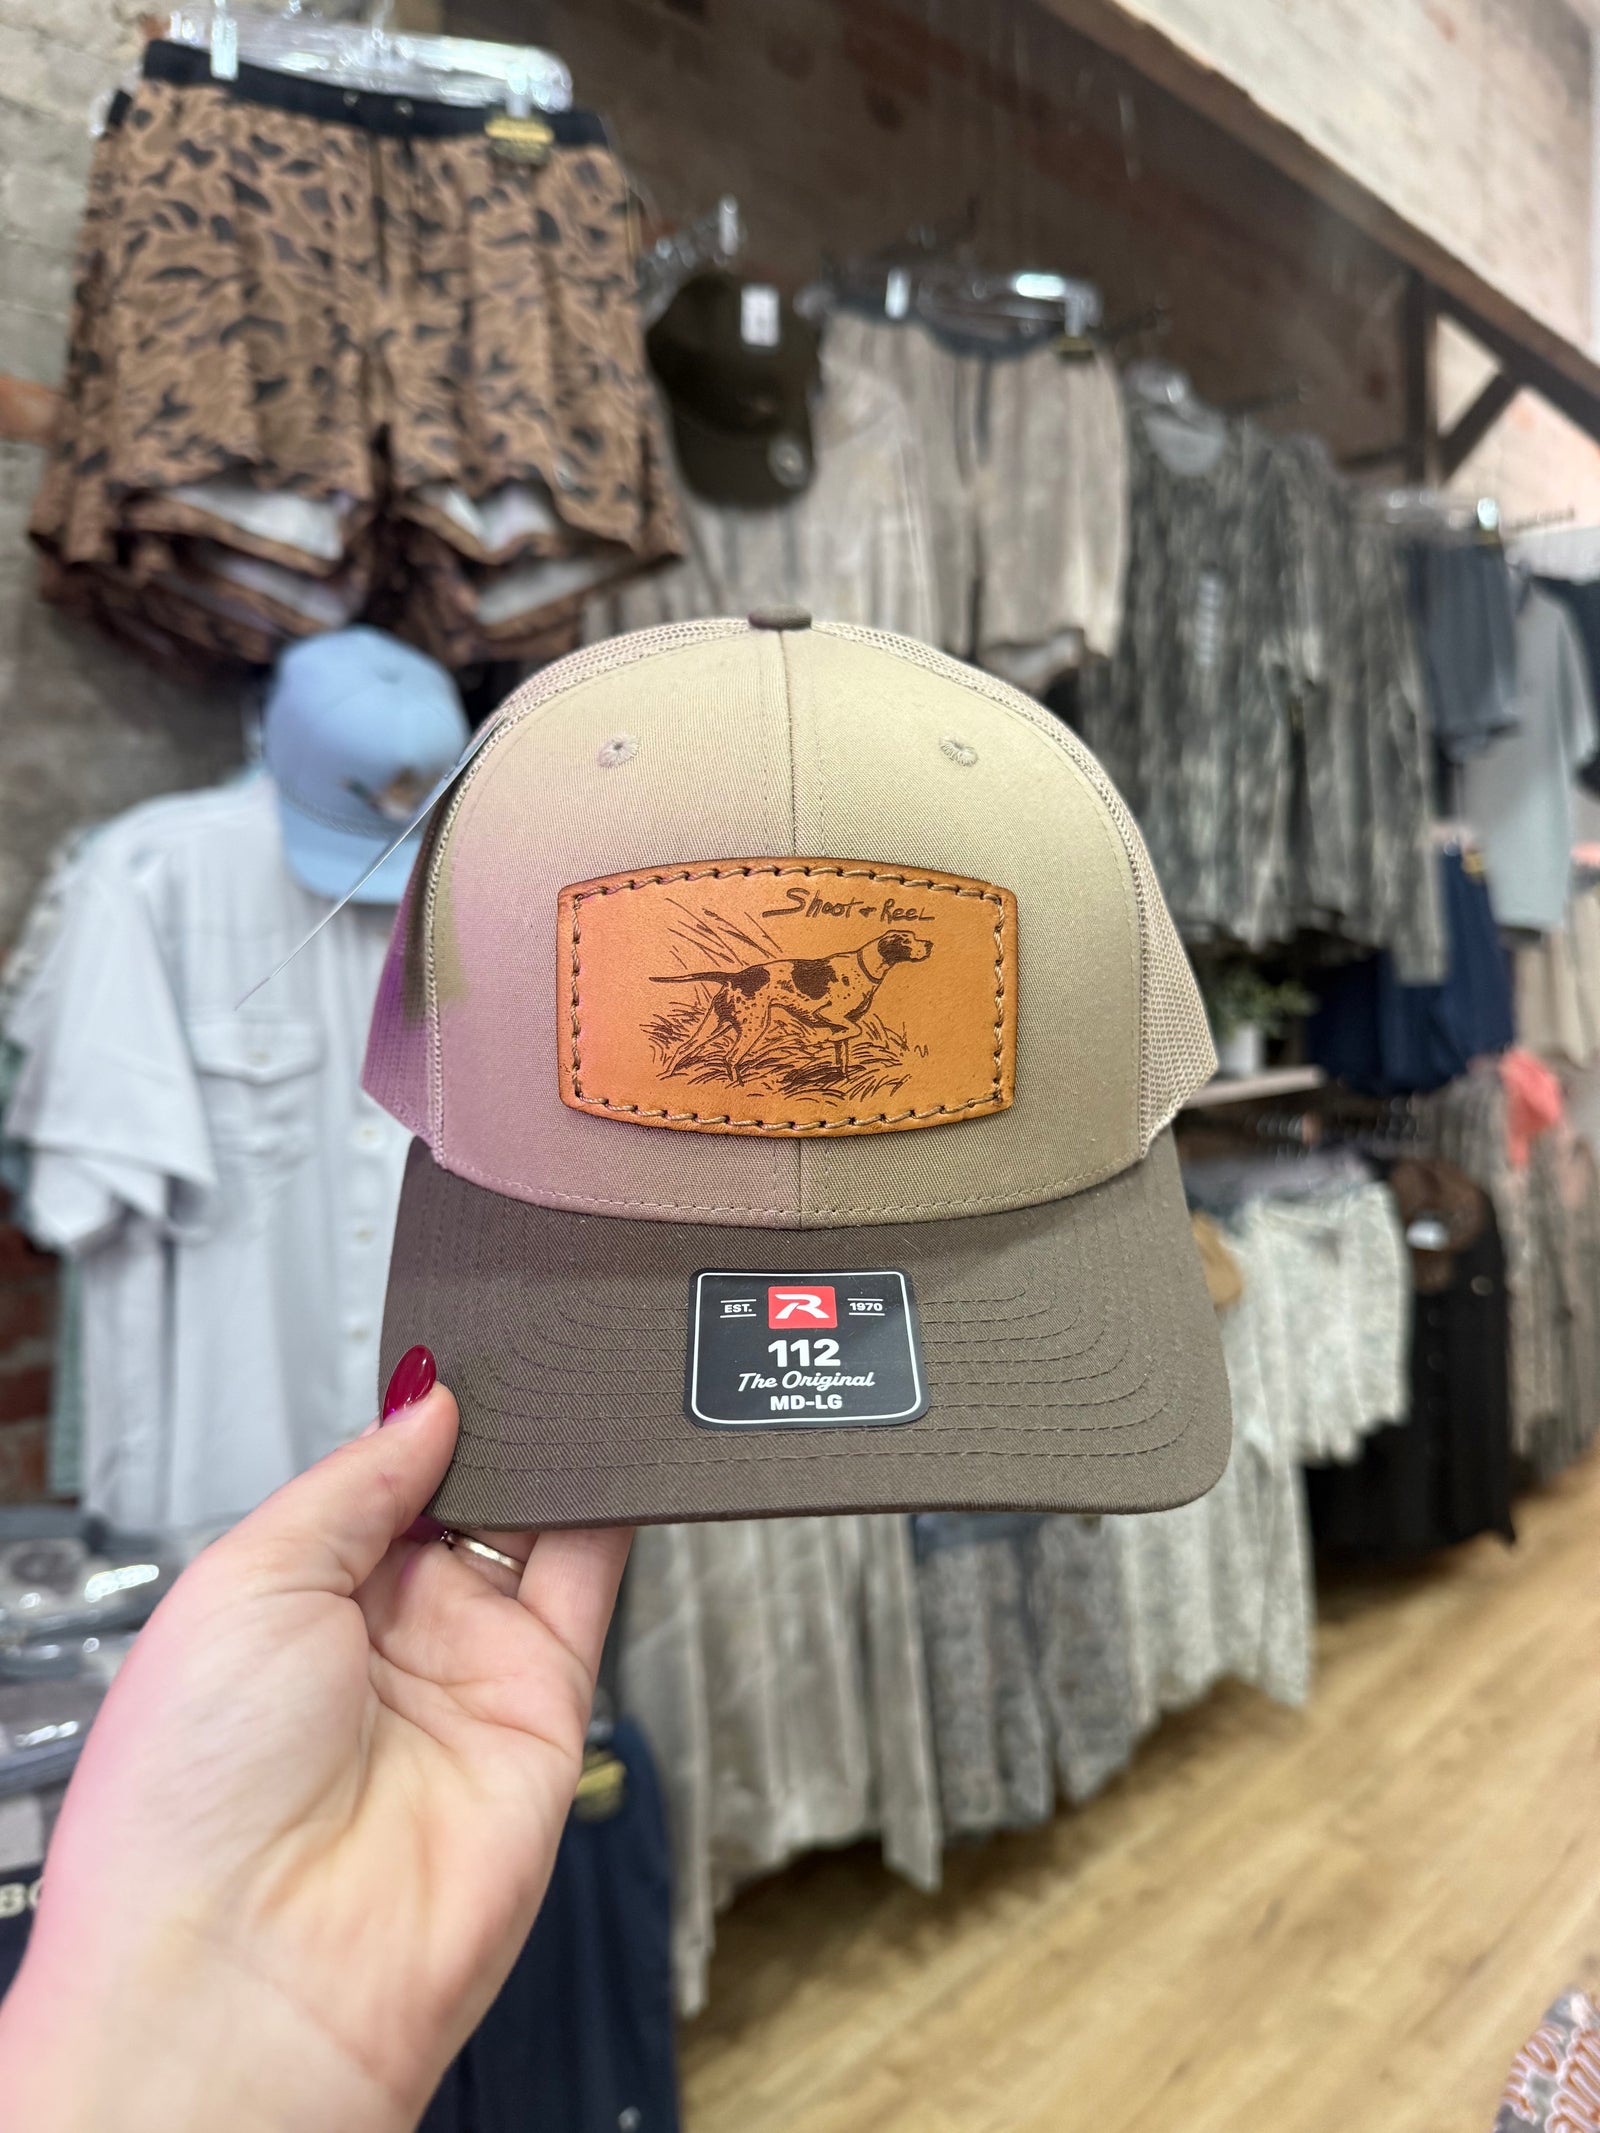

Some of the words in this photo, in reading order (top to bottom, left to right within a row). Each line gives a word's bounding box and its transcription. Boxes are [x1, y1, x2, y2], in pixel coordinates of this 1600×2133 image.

[762, 887, 864, 918] Shoot
[724, 1303, 753, 1313] EST.
[850, 1302, 883, 1312] 1970
[768, 1338, 841, 1367] 112
[738, 1372, 778, 1392] The
[782, 1370, 875, 1391] Original
[770, 1394, 843, 1411] MD-LG
